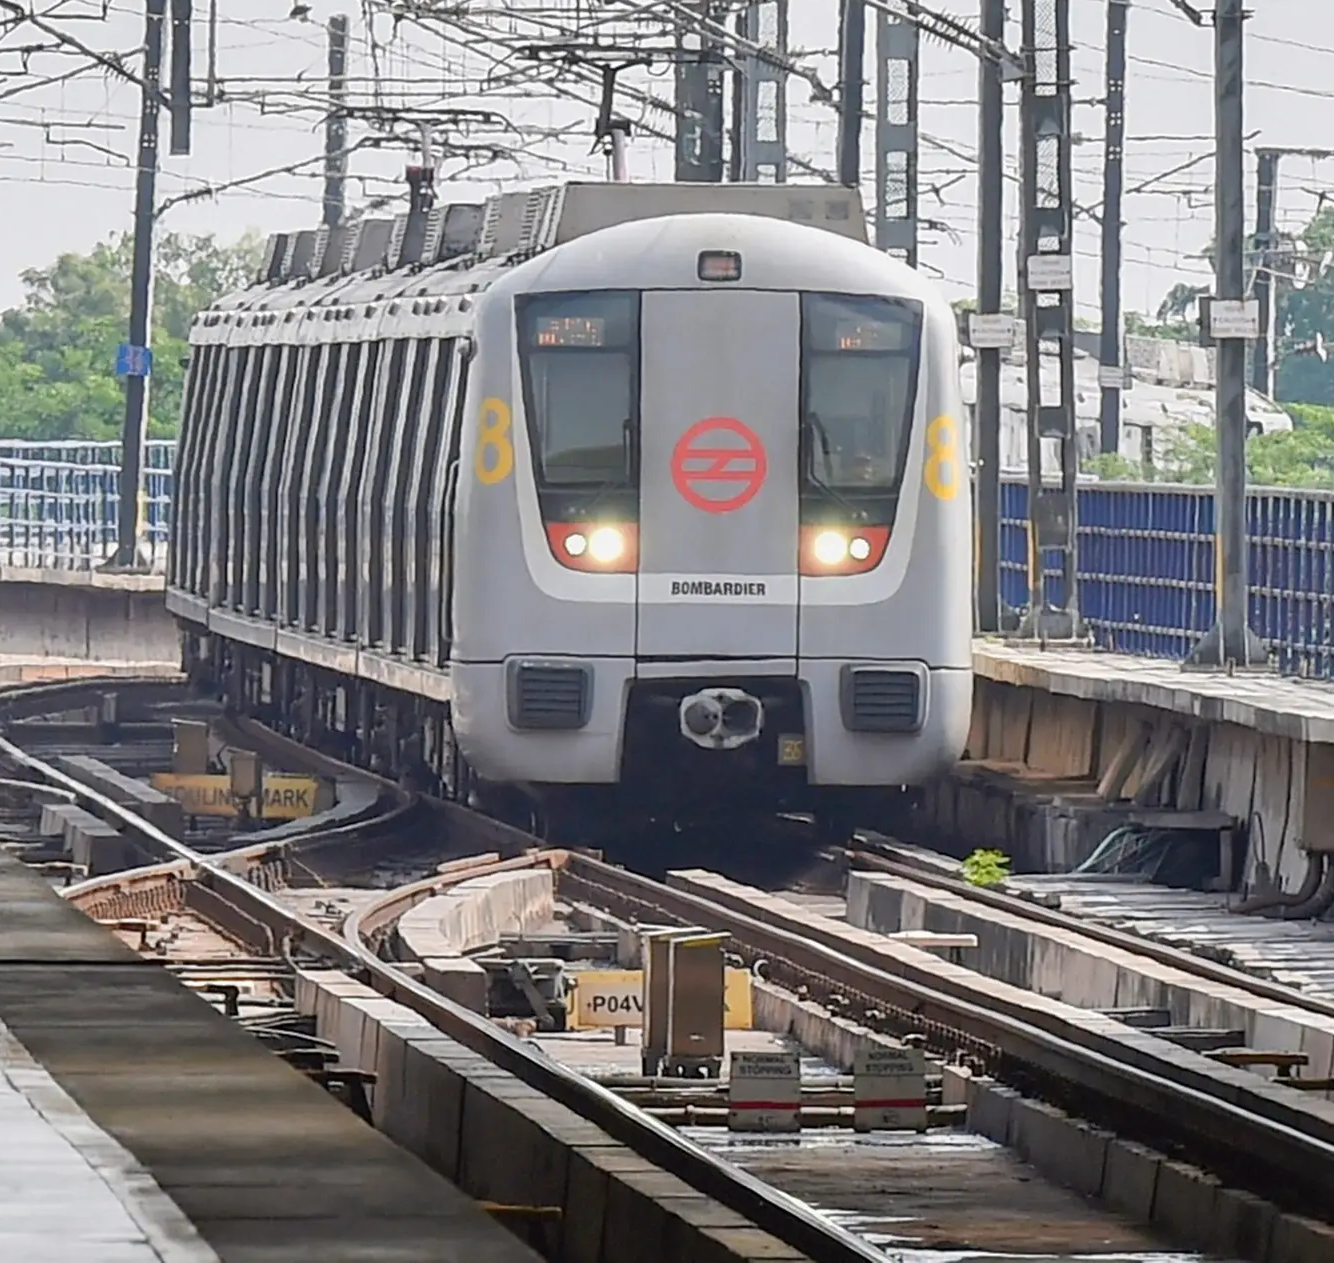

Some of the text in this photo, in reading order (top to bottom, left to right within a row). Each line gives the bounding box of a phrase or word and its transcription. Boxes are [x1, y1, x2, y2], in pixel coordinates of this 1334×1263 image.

[475, 397, 514, 485] 8
[923, 414, 960, 501] 8
[671, 581, 766, 596] BOMBARDIER
